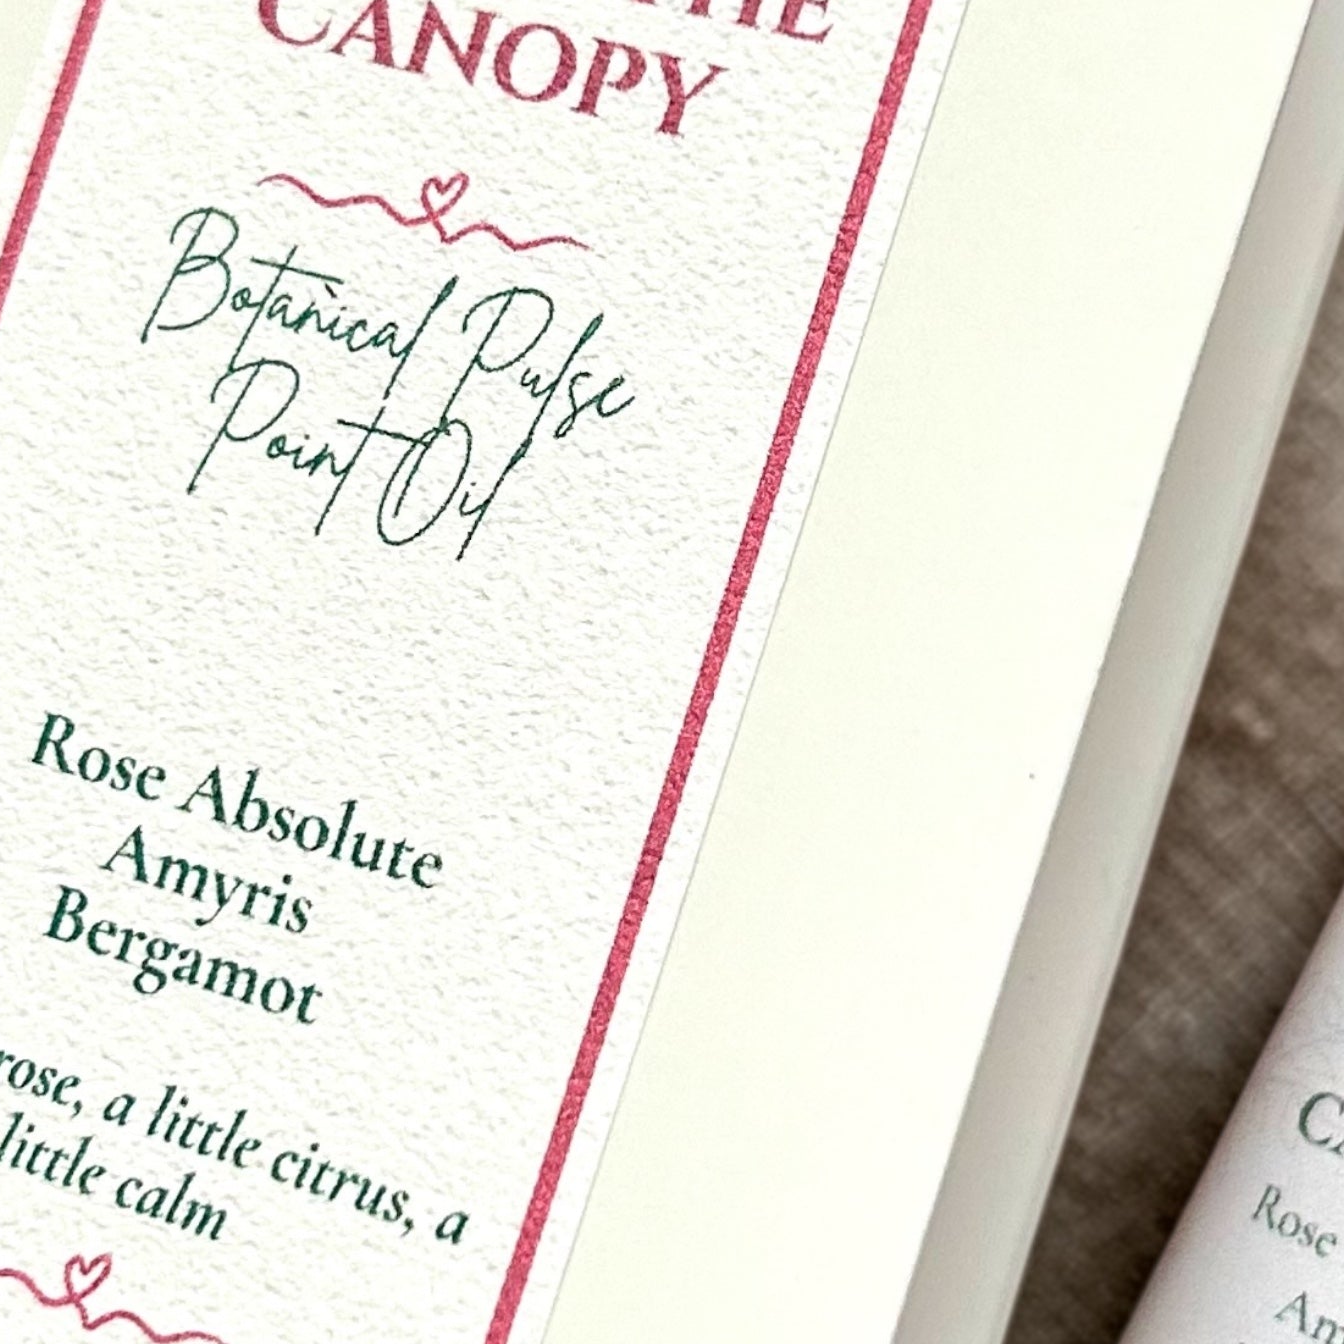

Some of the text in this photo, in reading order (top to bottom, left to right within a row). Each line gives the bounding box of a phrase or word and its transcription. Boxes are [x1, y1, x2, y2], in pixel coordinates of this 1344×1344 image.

[140, 206, 637, 444] Botanical Pulse
[187, 359, 534, 560] Point Oil
[32, 712, 445, 890] Rose Absolute
[43, 885, 324, 1024] Bergamot
[99, 825, 315, 935] Amyris
[103, 1093, 137, 1126] a
[148, 1085, 262, 1171] little
[273, 1140, 417, 1234] citrus,
[436, 1209, 471, 1245] a
[115, 1164, 229, 1241] calm
[1252, 1185, 1338, 1259] Rose
